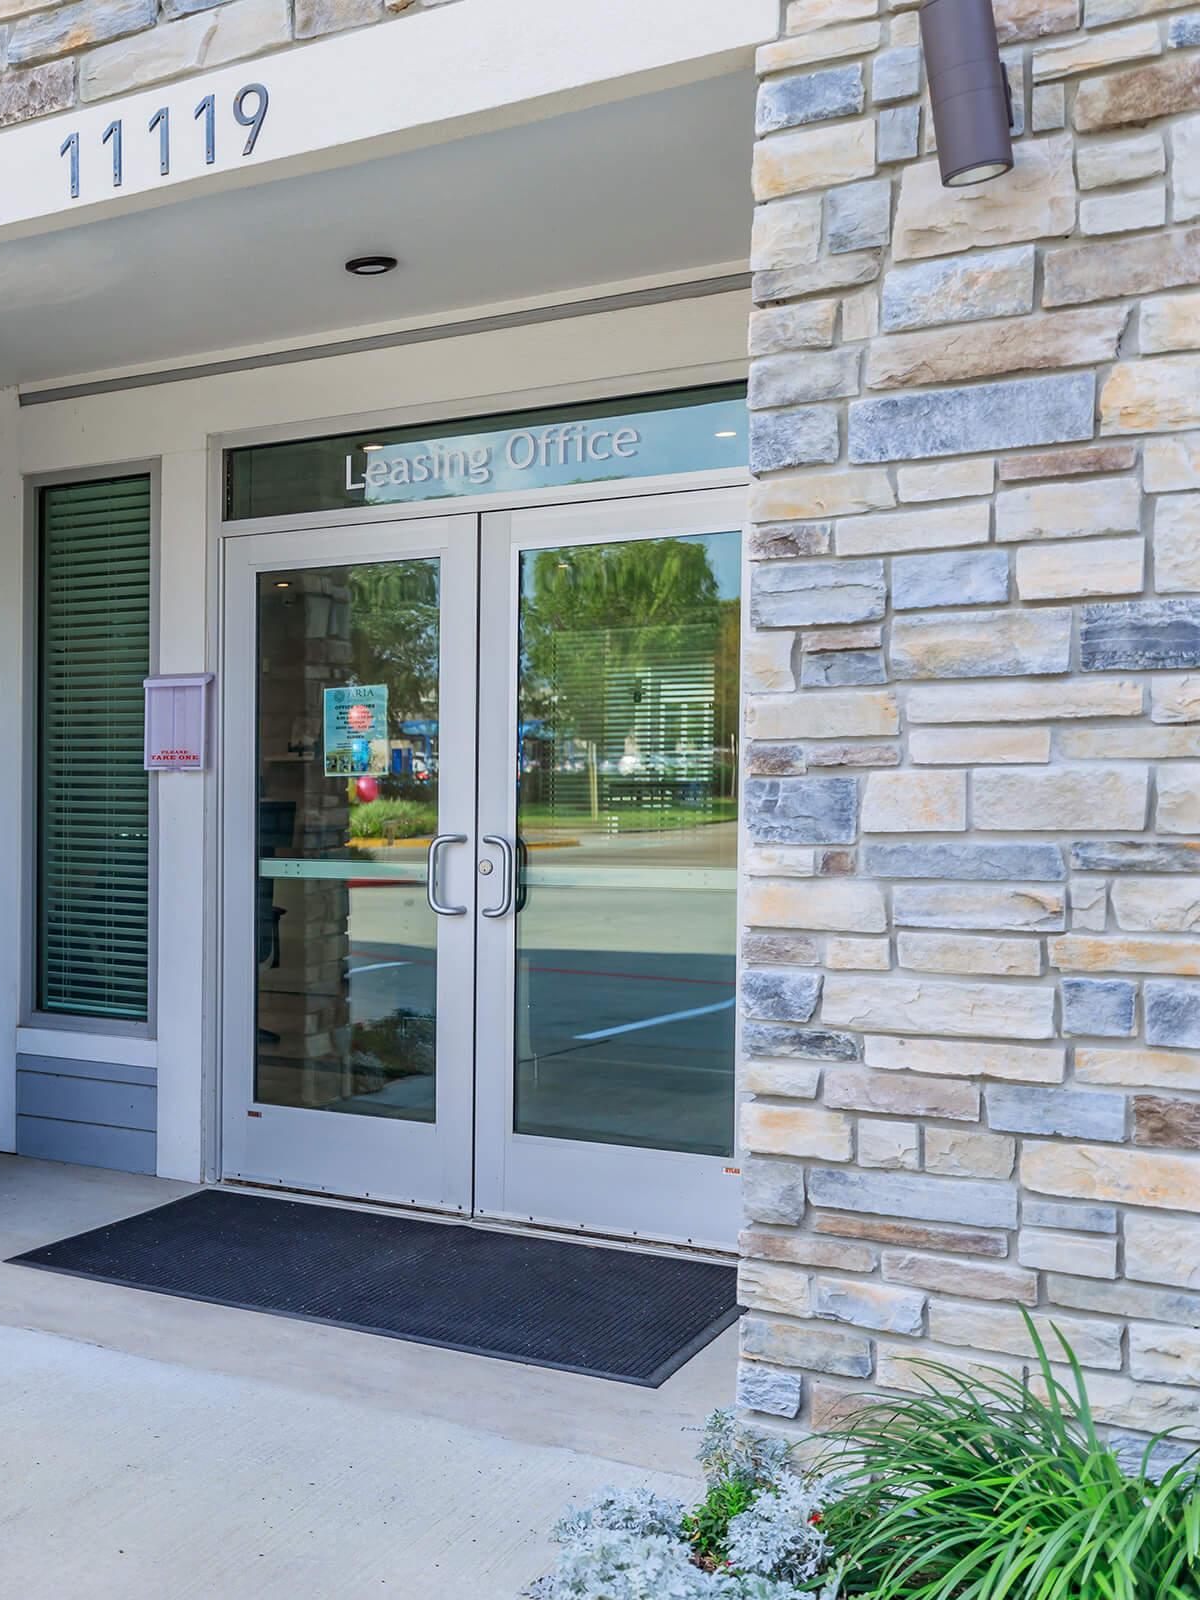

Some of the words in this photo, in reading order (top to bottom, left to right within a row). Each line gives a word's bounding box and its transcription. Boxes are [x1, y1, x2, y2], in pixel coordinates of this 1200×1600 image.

[59, 82, 270, 199] 11119
[345, 442, 494, 491] Leasing
[505, 423, 642, 471] Office
[347, 688, 375, 698] ARIA
